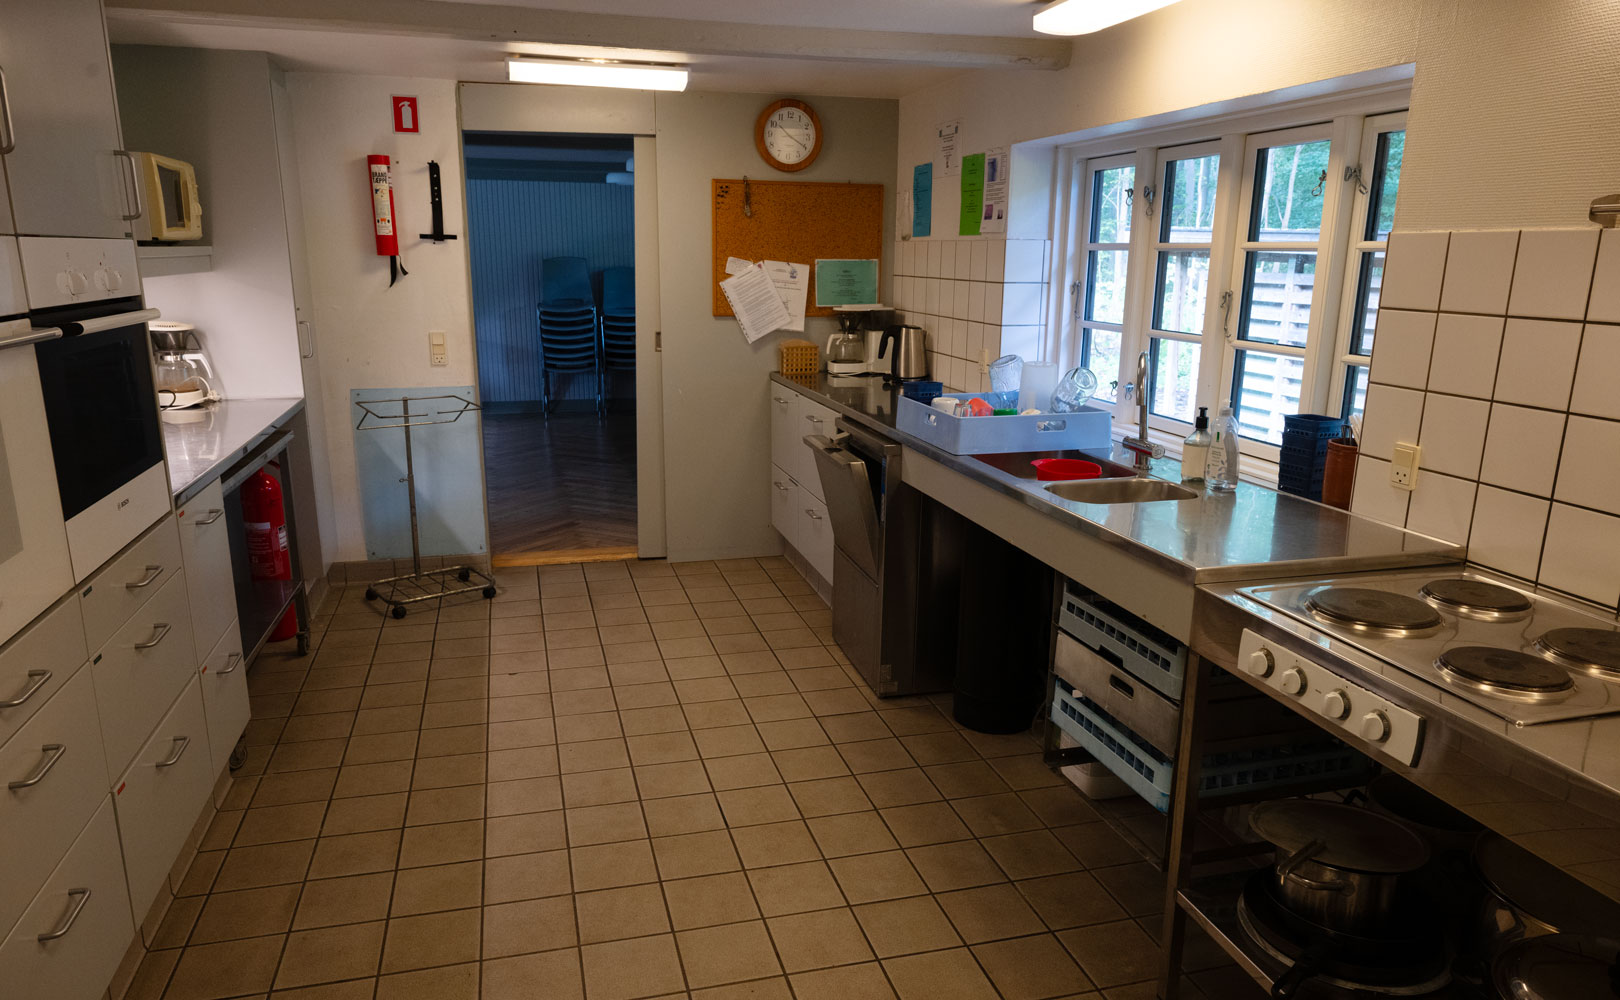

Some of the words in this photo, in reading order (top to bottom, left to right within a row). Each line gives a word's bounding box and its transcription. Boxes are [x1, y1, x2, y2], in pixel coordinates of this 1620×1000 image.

[778, 113, 784, 121] 11
[787, 111, 795, 119] 12
[770, 120, 778, 128] 10
[777, 149, 782, 157] 7
